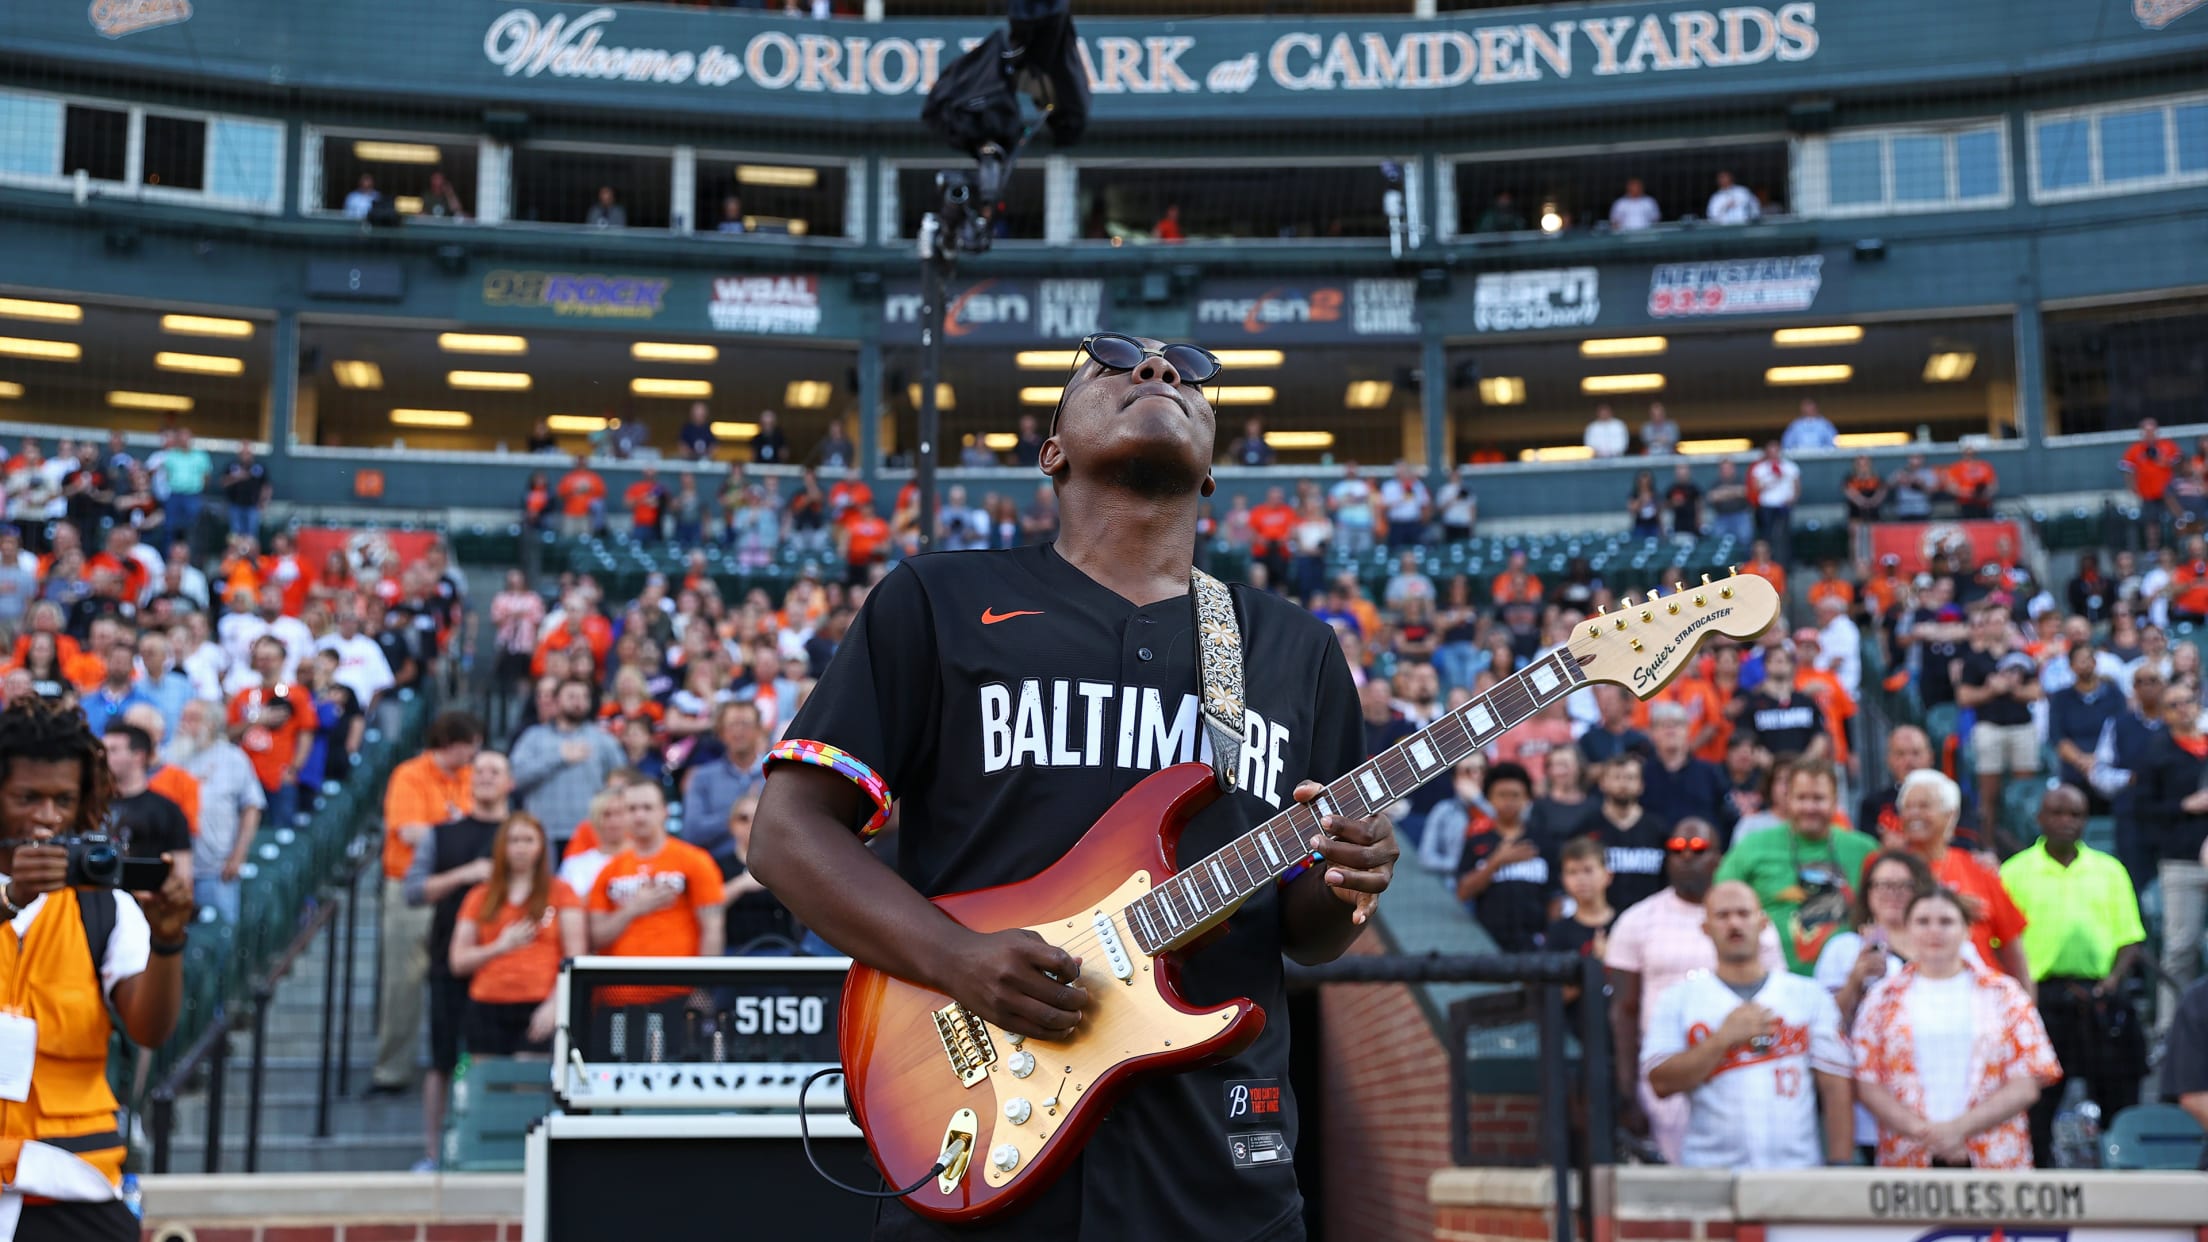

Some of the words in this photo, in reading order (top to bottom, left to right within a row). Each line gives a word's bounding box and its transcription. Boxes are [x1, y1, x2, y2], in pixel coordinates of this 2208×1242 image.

[484, 8, 695, 84] Welcome
[695, 45, 744, 86] to
[744, 31, 986, 94] ORIOL
[1206, 51, 1260, 93] at
[1268, 21, 1577, 91] CAMDEN
[1580, 2, 1820, 76] YARDS
[714, 276, 817, 304] WBAL
[1633, 644, 1676, 689] Squier
[1674, 606, 1731, 645] STRATOCASTER
[980, 680, 1290, 810] BALTIMRE
[735, 996, 824, 1035] 5150
[1229, 1084, 1248, 1118] B
[1868, 1180, 2085, 1218] ORIOLES.COM
